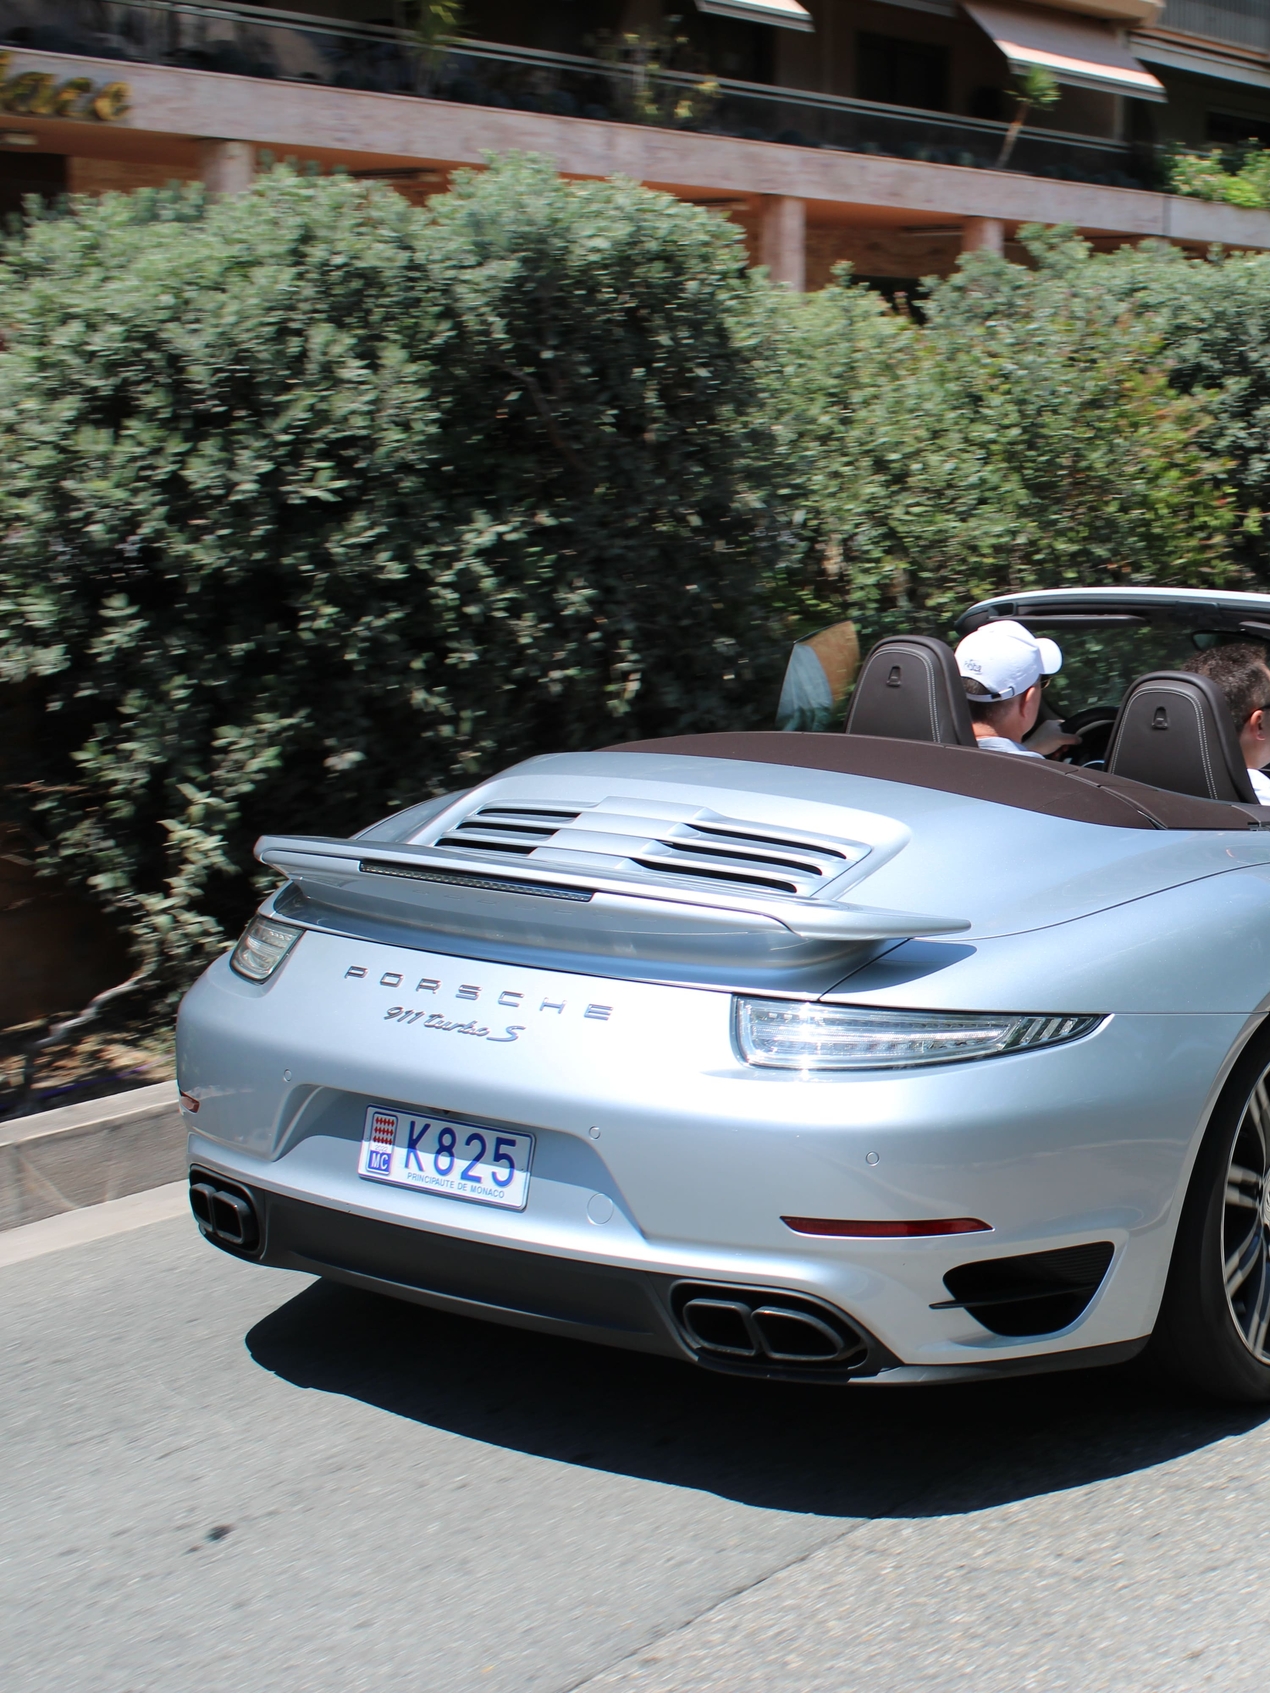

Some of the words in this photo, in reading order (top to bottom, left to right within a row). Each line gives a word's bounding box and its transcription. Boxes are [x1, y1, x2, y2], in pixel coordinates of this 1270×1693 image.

[344, 965, 614, 1021] PORSCHE
[384, 1006, 425, 1024] 911
[423, 1012, 491, 1037] turbo
[486, 1025, 526, 1042] S
[370, 1151, 389, 1170] MC
[405, 1120, 517, 1188] K825
[406, 1171, 456, 1190] PRINCIPAUTE
[457, 1183, 469, 1192] DE
[469, 1185, 506, 1199] MONACO
